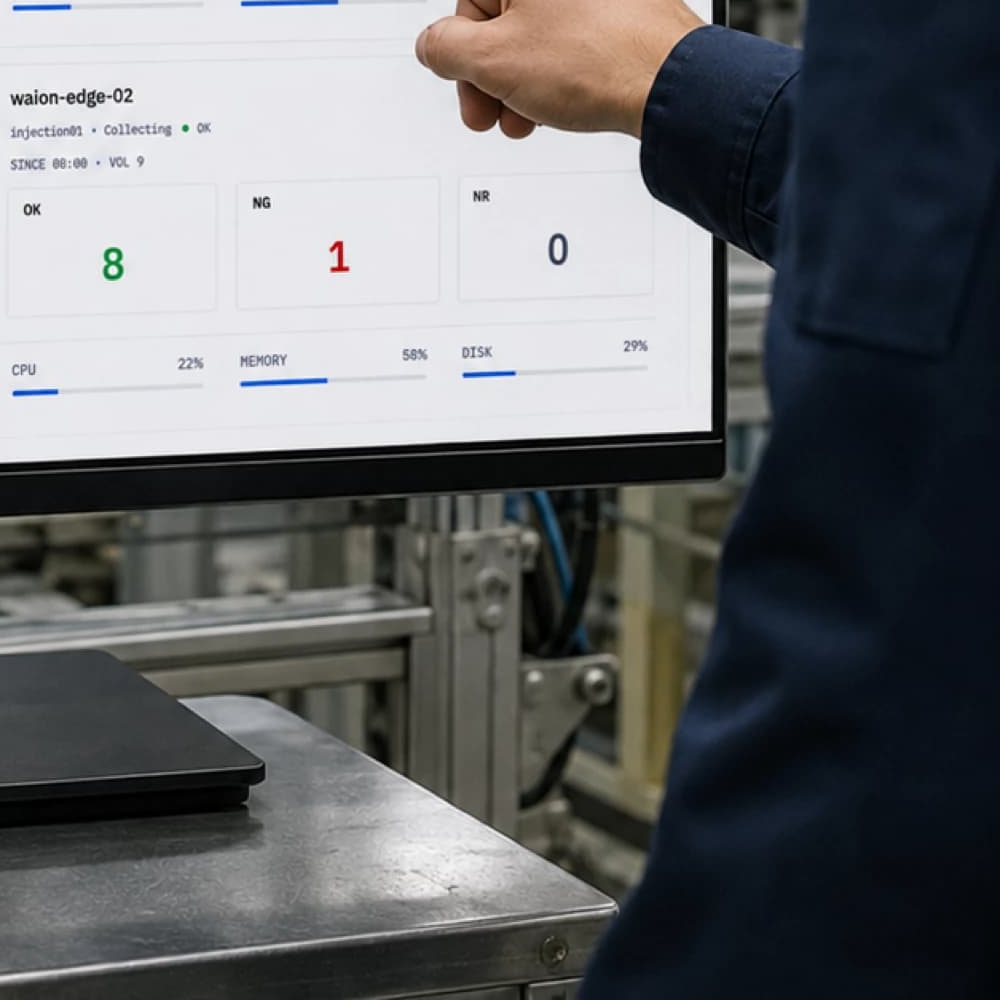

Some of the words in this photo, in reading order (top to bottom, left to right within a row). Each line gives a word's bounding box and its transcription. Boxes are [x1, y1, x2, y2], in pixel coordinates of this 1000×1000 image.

[10, 88, 133, 108] waion-edge-02
[11, 125, 83, 140] injection01
[104, 123, 172, 137] Collecting
[197, 123, 211, 134] OK
[11, 158, 46, 171] SINCE
[109, 156, 130, 168] VOL
[137, 156, 144, 167] 9
[253, 196, 271, 209] NG
[473, 190, 490, 202] NR
[24, 203, 41, 216] OK
[548, 233, 568, 265] 0
[329, 241, 350, 273] 1
[103, 247, 124, 281] 8
[462, 346, 492, 359] DISK
[624, 340, 648, 352] 29%
[178, 357, 204, 370] 22%
[240, 354, 287, 368] MEMORY
[12, 363, 36, 376] CPU
